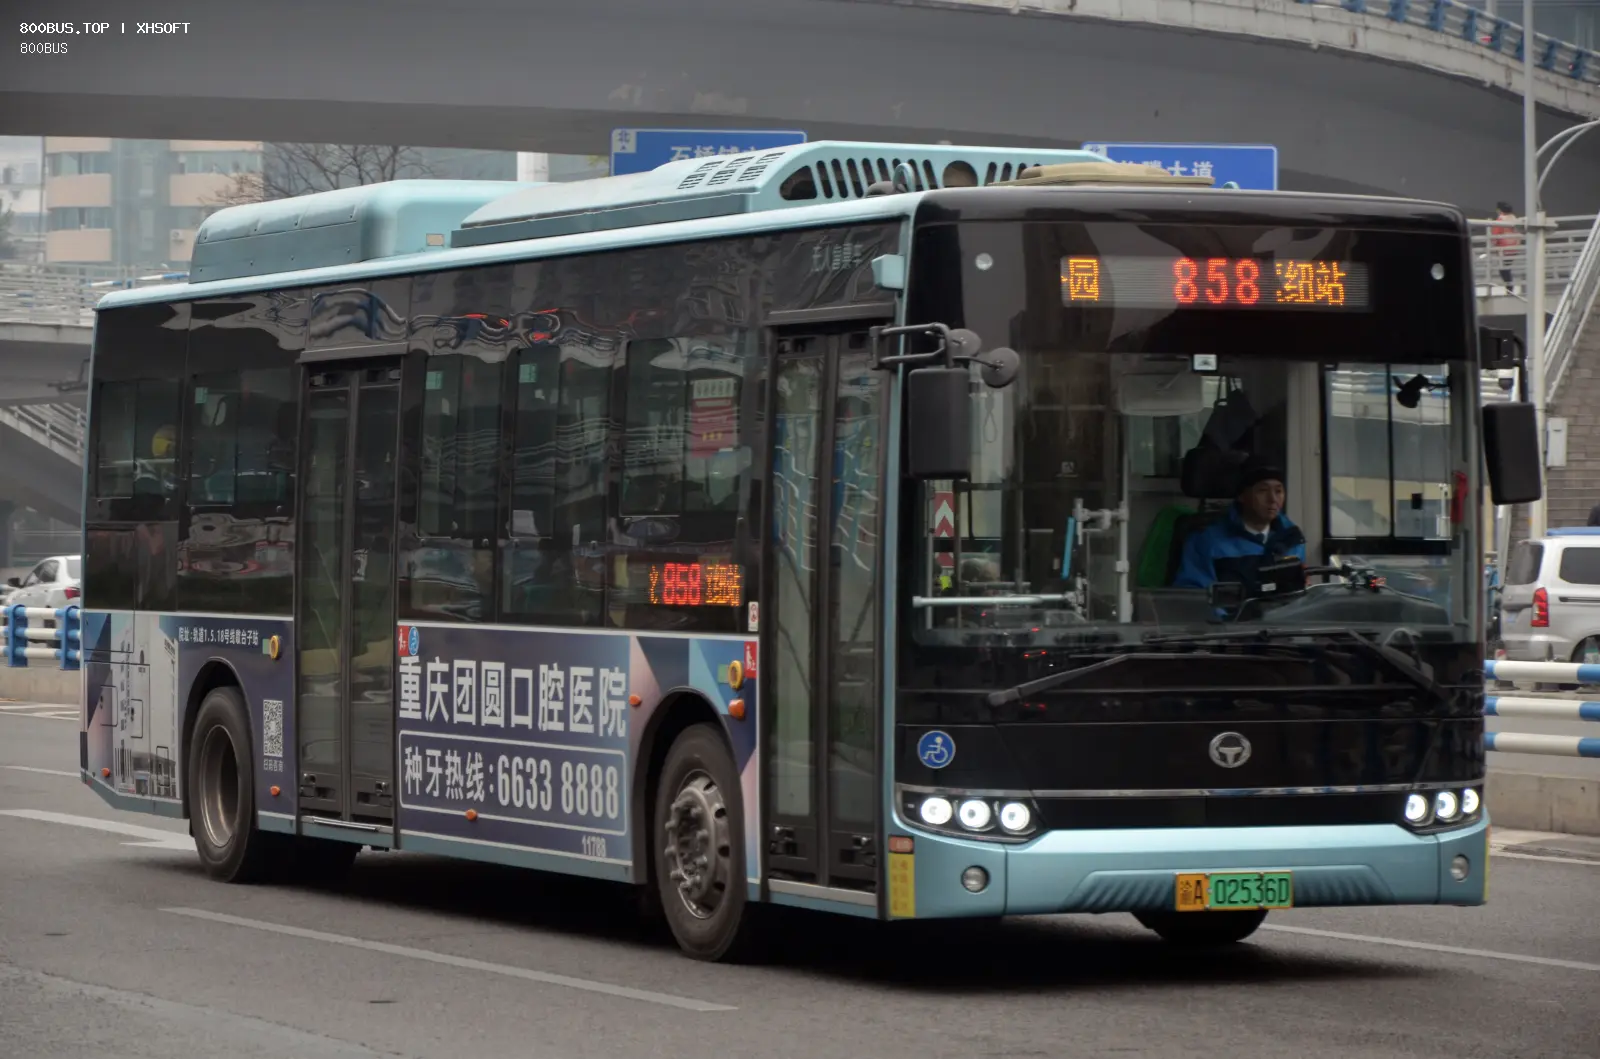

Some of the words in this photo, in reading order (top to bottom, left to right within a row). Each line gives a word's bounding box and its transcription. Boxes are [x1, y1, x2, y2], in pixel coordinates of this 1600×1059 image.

[1061, 258, 1099, 301] 园
[1172, 257, 1260, 305] 858
[1275, 260, 1346, 306] 纽站
[663, 563, 701, 606] 858
[399, 655, 627, 738] 重庆团圆口腔医院
[561, 761, 619, 820] 8888
